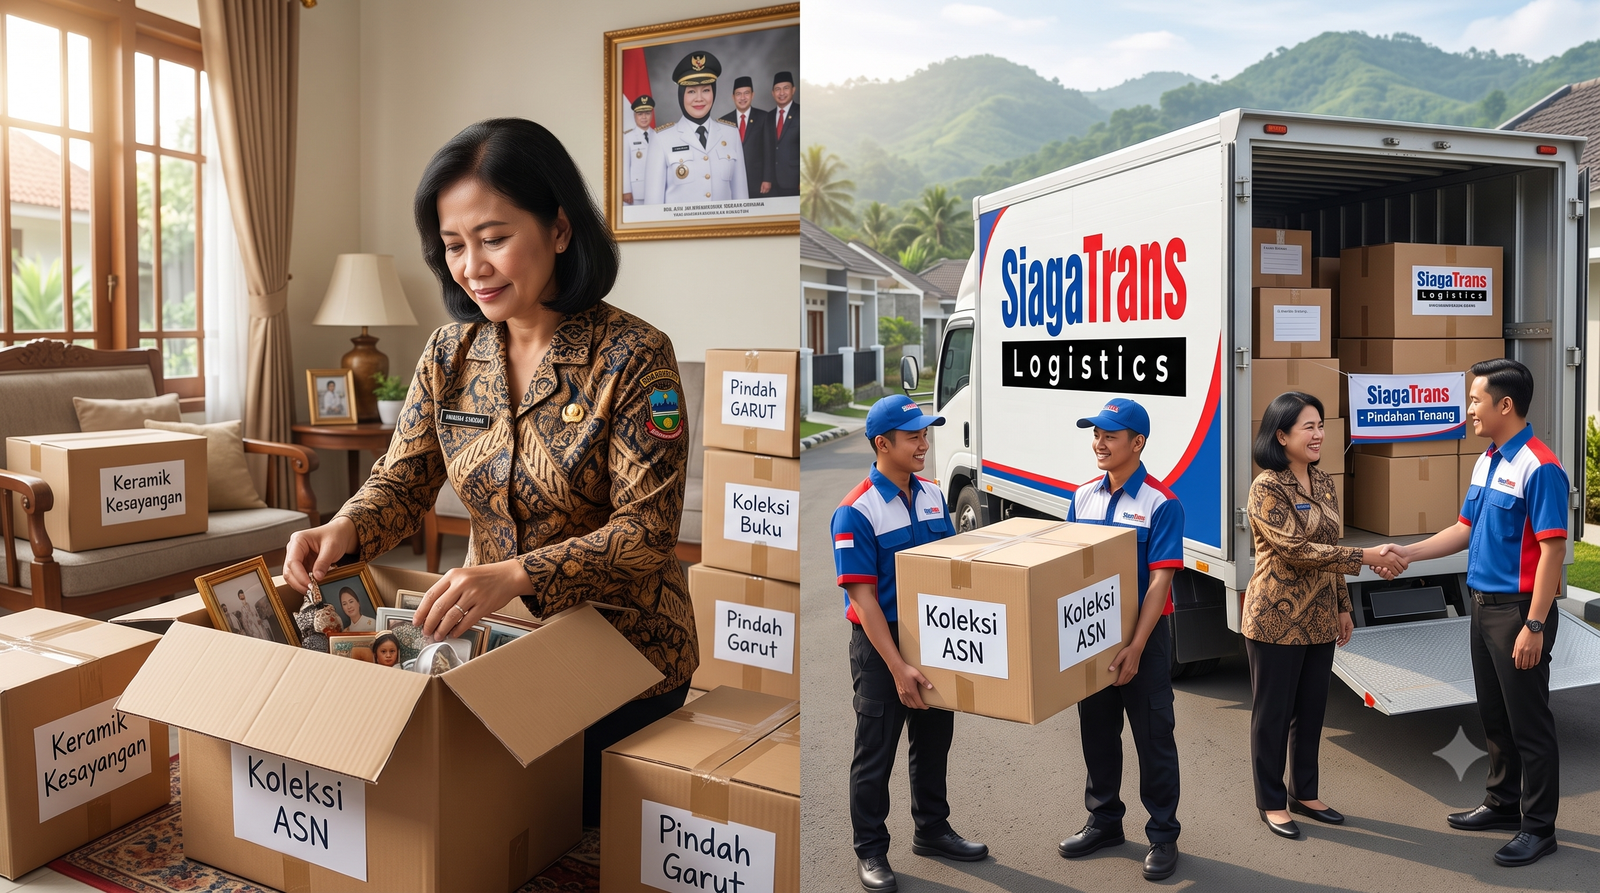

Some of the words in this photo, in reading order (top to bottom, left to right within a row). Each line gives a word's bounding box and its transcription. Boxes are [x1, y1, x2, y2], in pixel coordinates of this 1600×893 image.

[1001, 233, 1187, 337] SiagaTrans
[1417, 271, 1487, 289] SiagaTrans
[1422, 290, 1483, 300] Logistics
[1013, 344, 1169, 386] Logistics
[731, 379, 777, 398] Pindah
[1367, 384, 1450, 407] SiagaTrans
[730, 401, 777, 419] GARUT
[1367, 411, 1416, 423] Pindahan
[1418, 409, 1455, 423] Tenang
[113, 469, 172, 491] Keramik
[106, 491, 183, 514] Kesayangan
[733, 492, 790, 516] Koleksi
[741, 515, 782, 537] Buku
[926, 604, 997, 635] Koleksi
[1063, 585, 1115, 628] Koleksi
[727, 609, 782, 636] Pindah
[1076, 619, 1106, 653] ASN
[727, 633, 778, 658] Garut
[942, 637, 984, 664] ASN
[51, 711, 129, 761] Keramik
[44, 738, 147, 798] Kesayangan
[248, 755, 342, 811] Koleksi
[273, 805, 328, 850] ASN
[659, 814, 750, 867] Pindah
[662, 852, 745, 893] Garut
